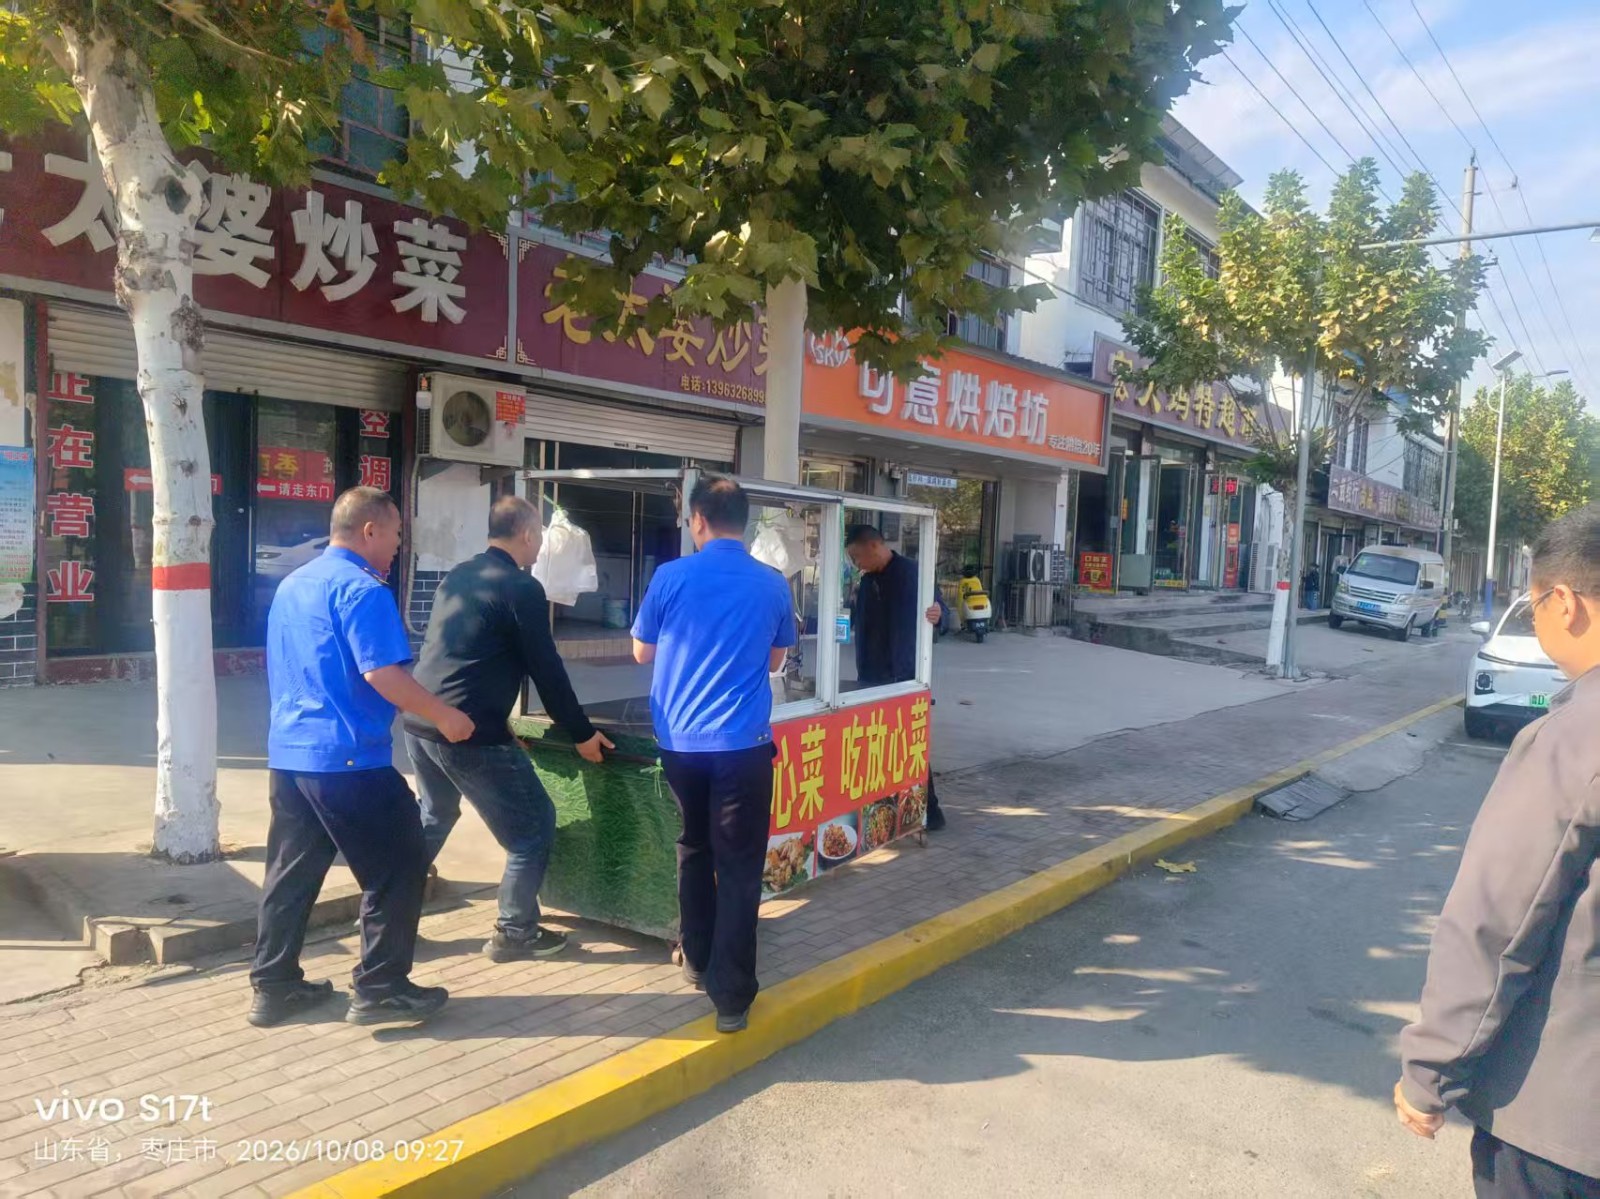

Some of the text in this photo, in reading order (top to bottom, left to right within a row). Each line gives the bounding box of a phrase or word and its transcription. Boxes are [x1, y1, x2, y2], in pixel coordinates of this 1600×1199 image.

[0, 134, 468, 324] 太婆炒菜
[681, 374, 767, 404] 电话:1396326899
[46, 372, 94, 602] 正在营业
[278, 482, 331, 499] 请走东门
[840, 697, 929, 801] 吃放心菜
